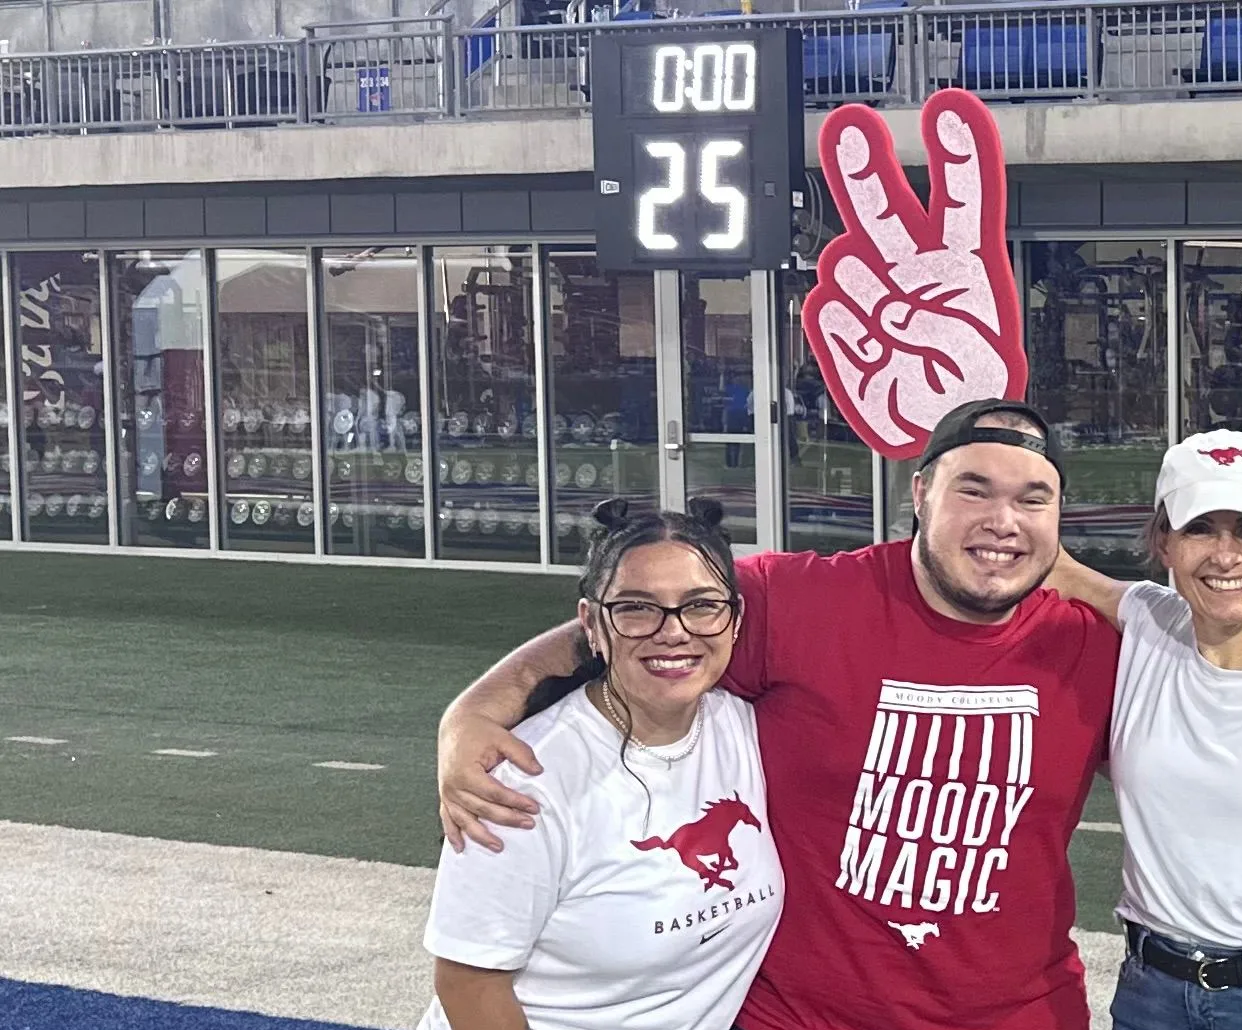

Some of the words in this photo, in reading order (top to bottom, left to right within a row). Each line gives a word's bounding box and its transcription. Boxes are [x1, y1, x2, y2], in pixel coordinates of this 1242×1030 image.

[653, 44, 756, 112] 0:00
[637, 140, 746, 250] 25
[895, 692, 942, 704] MOODY
[849, 771, 1035, 846] MOODY
[834, 824, 1009, 915] MAGIC
[654, 884, 775, 935] BASKETBALL
